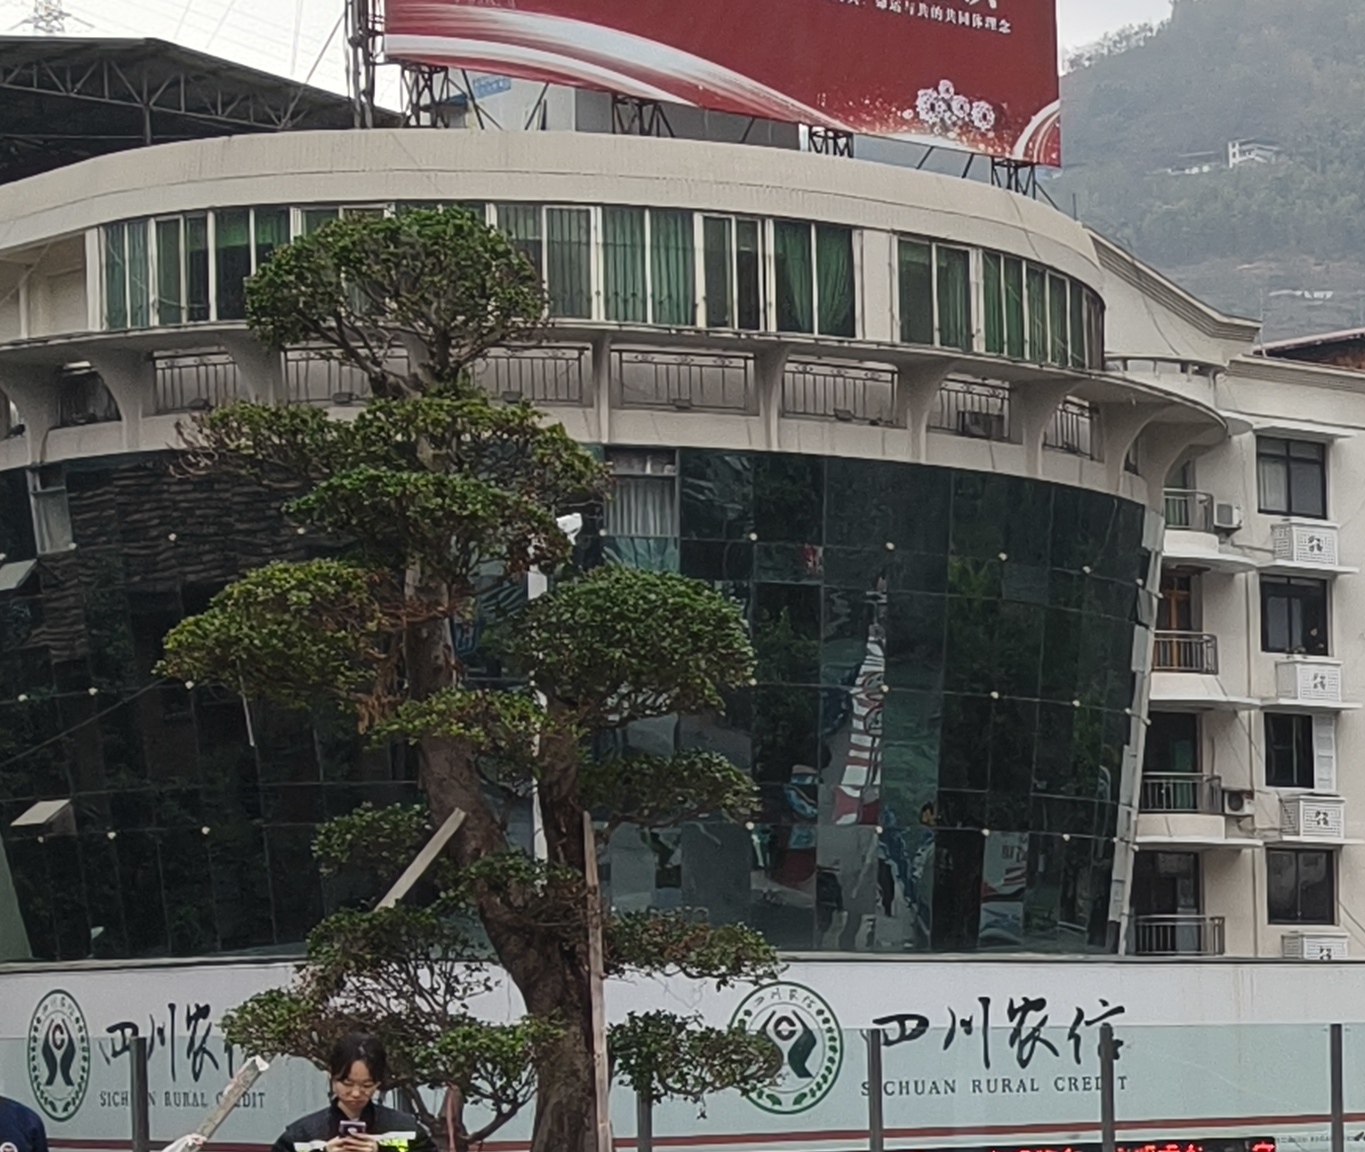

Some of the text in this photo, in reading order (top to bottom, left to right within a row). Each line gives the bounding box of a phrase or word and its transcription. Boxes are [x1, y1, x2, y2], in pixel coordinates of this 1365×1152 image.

[860, 997, 1127, 1069] 四川农信
[861, 1075, 1128, 1096] SCHUAN RURAL CREDT
[99, 1091, 156, 1107] SICHN
[164, 1091, 209, 1107] RURAL
